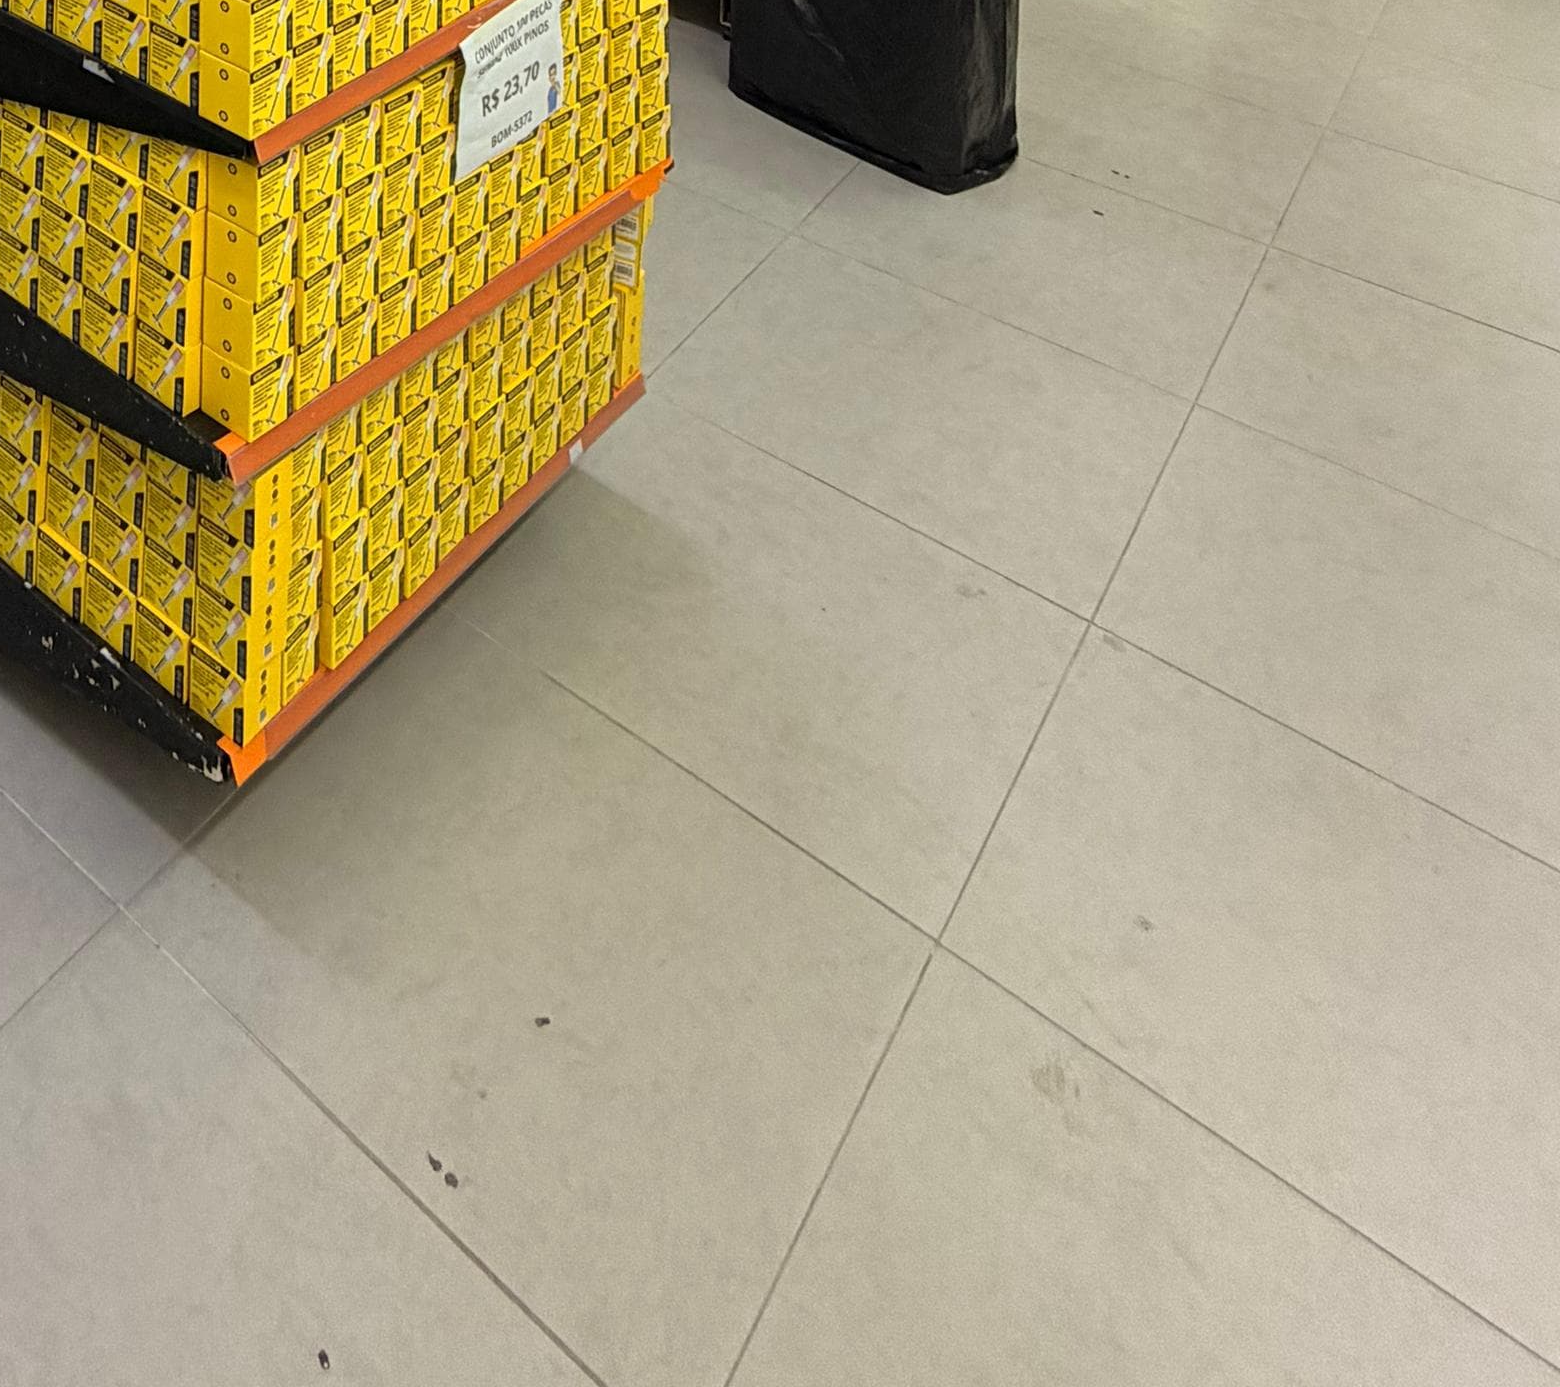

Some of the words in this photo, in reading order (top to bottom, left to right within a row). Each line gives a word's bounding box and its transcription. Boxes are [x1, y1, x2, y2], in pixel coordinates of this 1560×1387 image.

[474, 24, 515, 65] CONJUNTO
[524, 20, 550, 48] PINOS
[481, 88, 500, 117] R$
[503, 60, 540, 103] 23,70
[491, 110, 533, 149] BOM-5372
